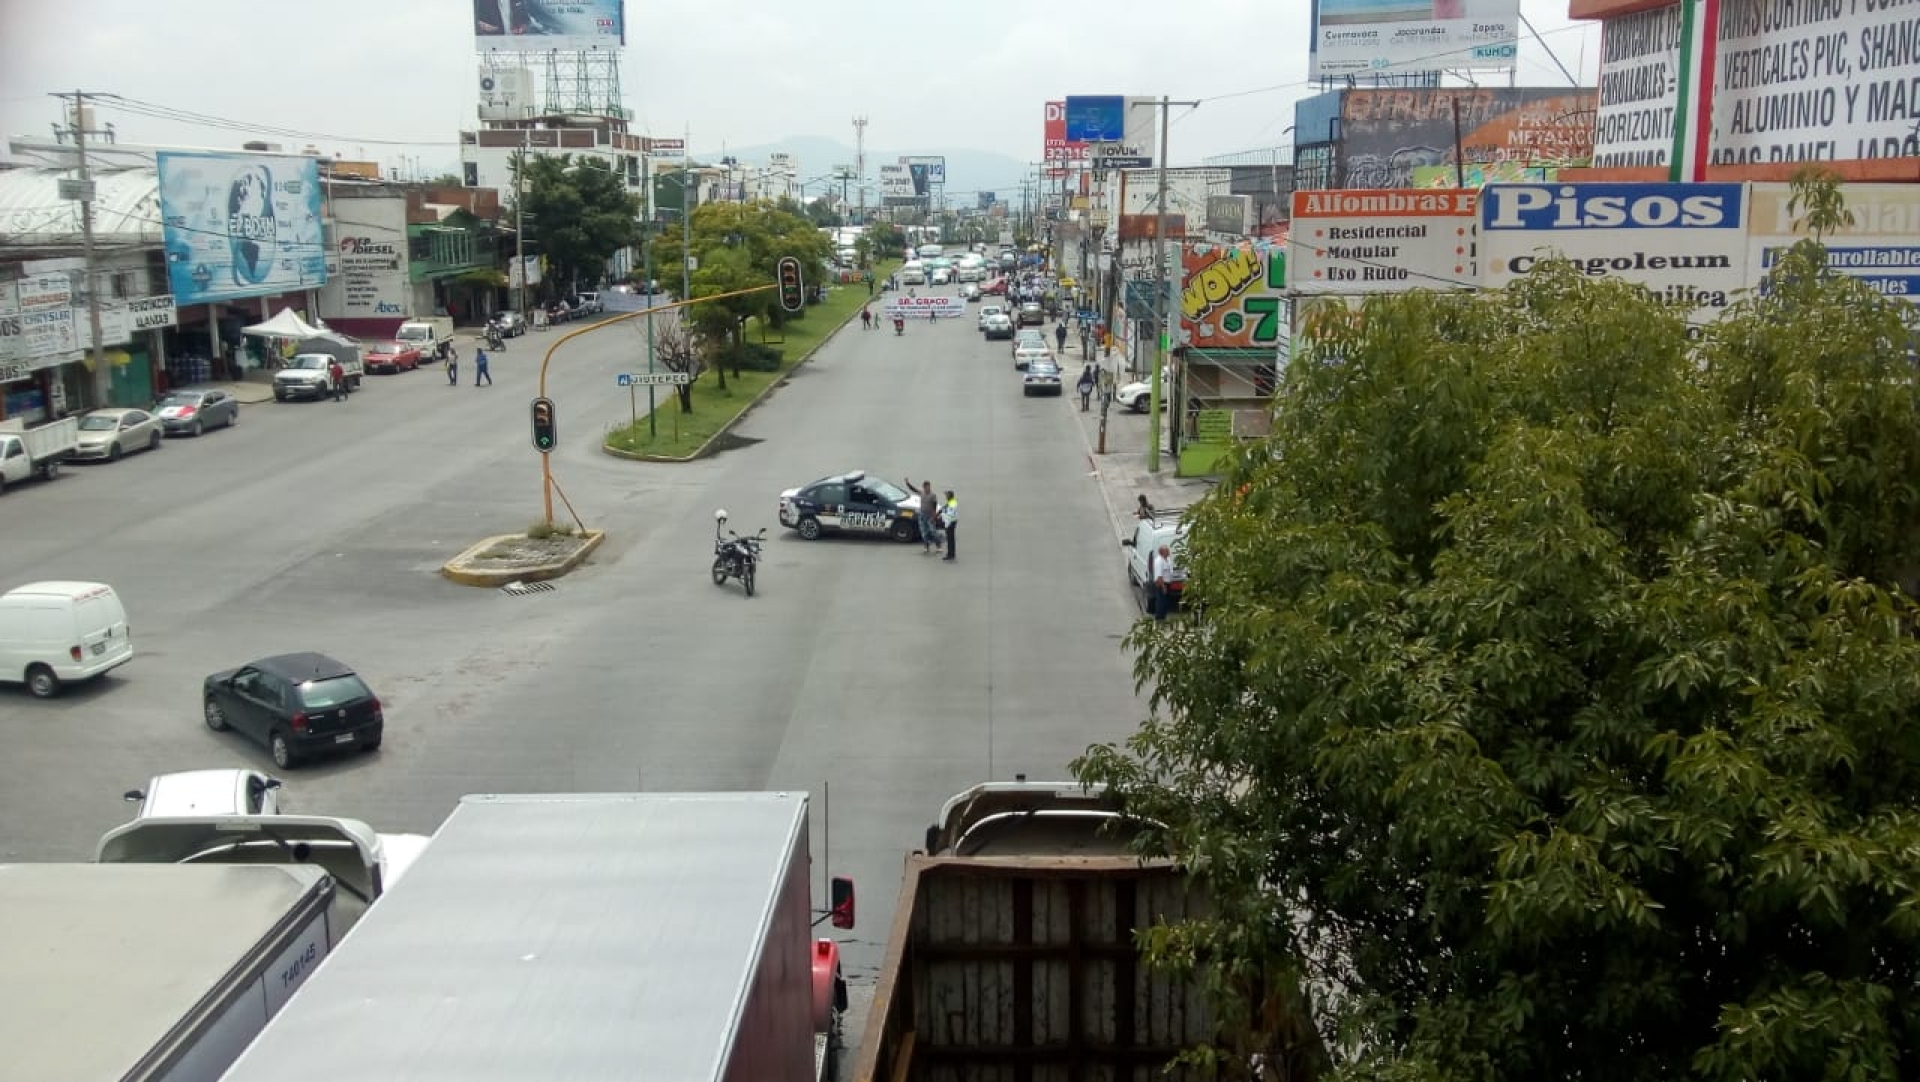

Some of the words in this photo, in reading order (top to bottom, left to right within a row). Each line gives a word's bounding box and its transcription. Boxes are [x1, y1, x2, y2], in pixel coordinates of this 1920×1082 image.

[1325, 31, 1379, 39] Cuernavaca
[1724, 38, 1809, 90] VERTICALES
[1814, 31, 1852, 79] PVC,
[1731, 86, 1835, 134] ALUMINIO
[1845, 84, 1860, 124] Y
[1305, 194, 1450, 213] Alfombras
[1490, 186, 1723, 227] Pisos
[1329, 224, 1427, 239] Residencial
[1327, 245, 1399, 259] Modular
[1327, 266, 1356, 281] Uso
[1363, 266, 1408, 280] Rudo
